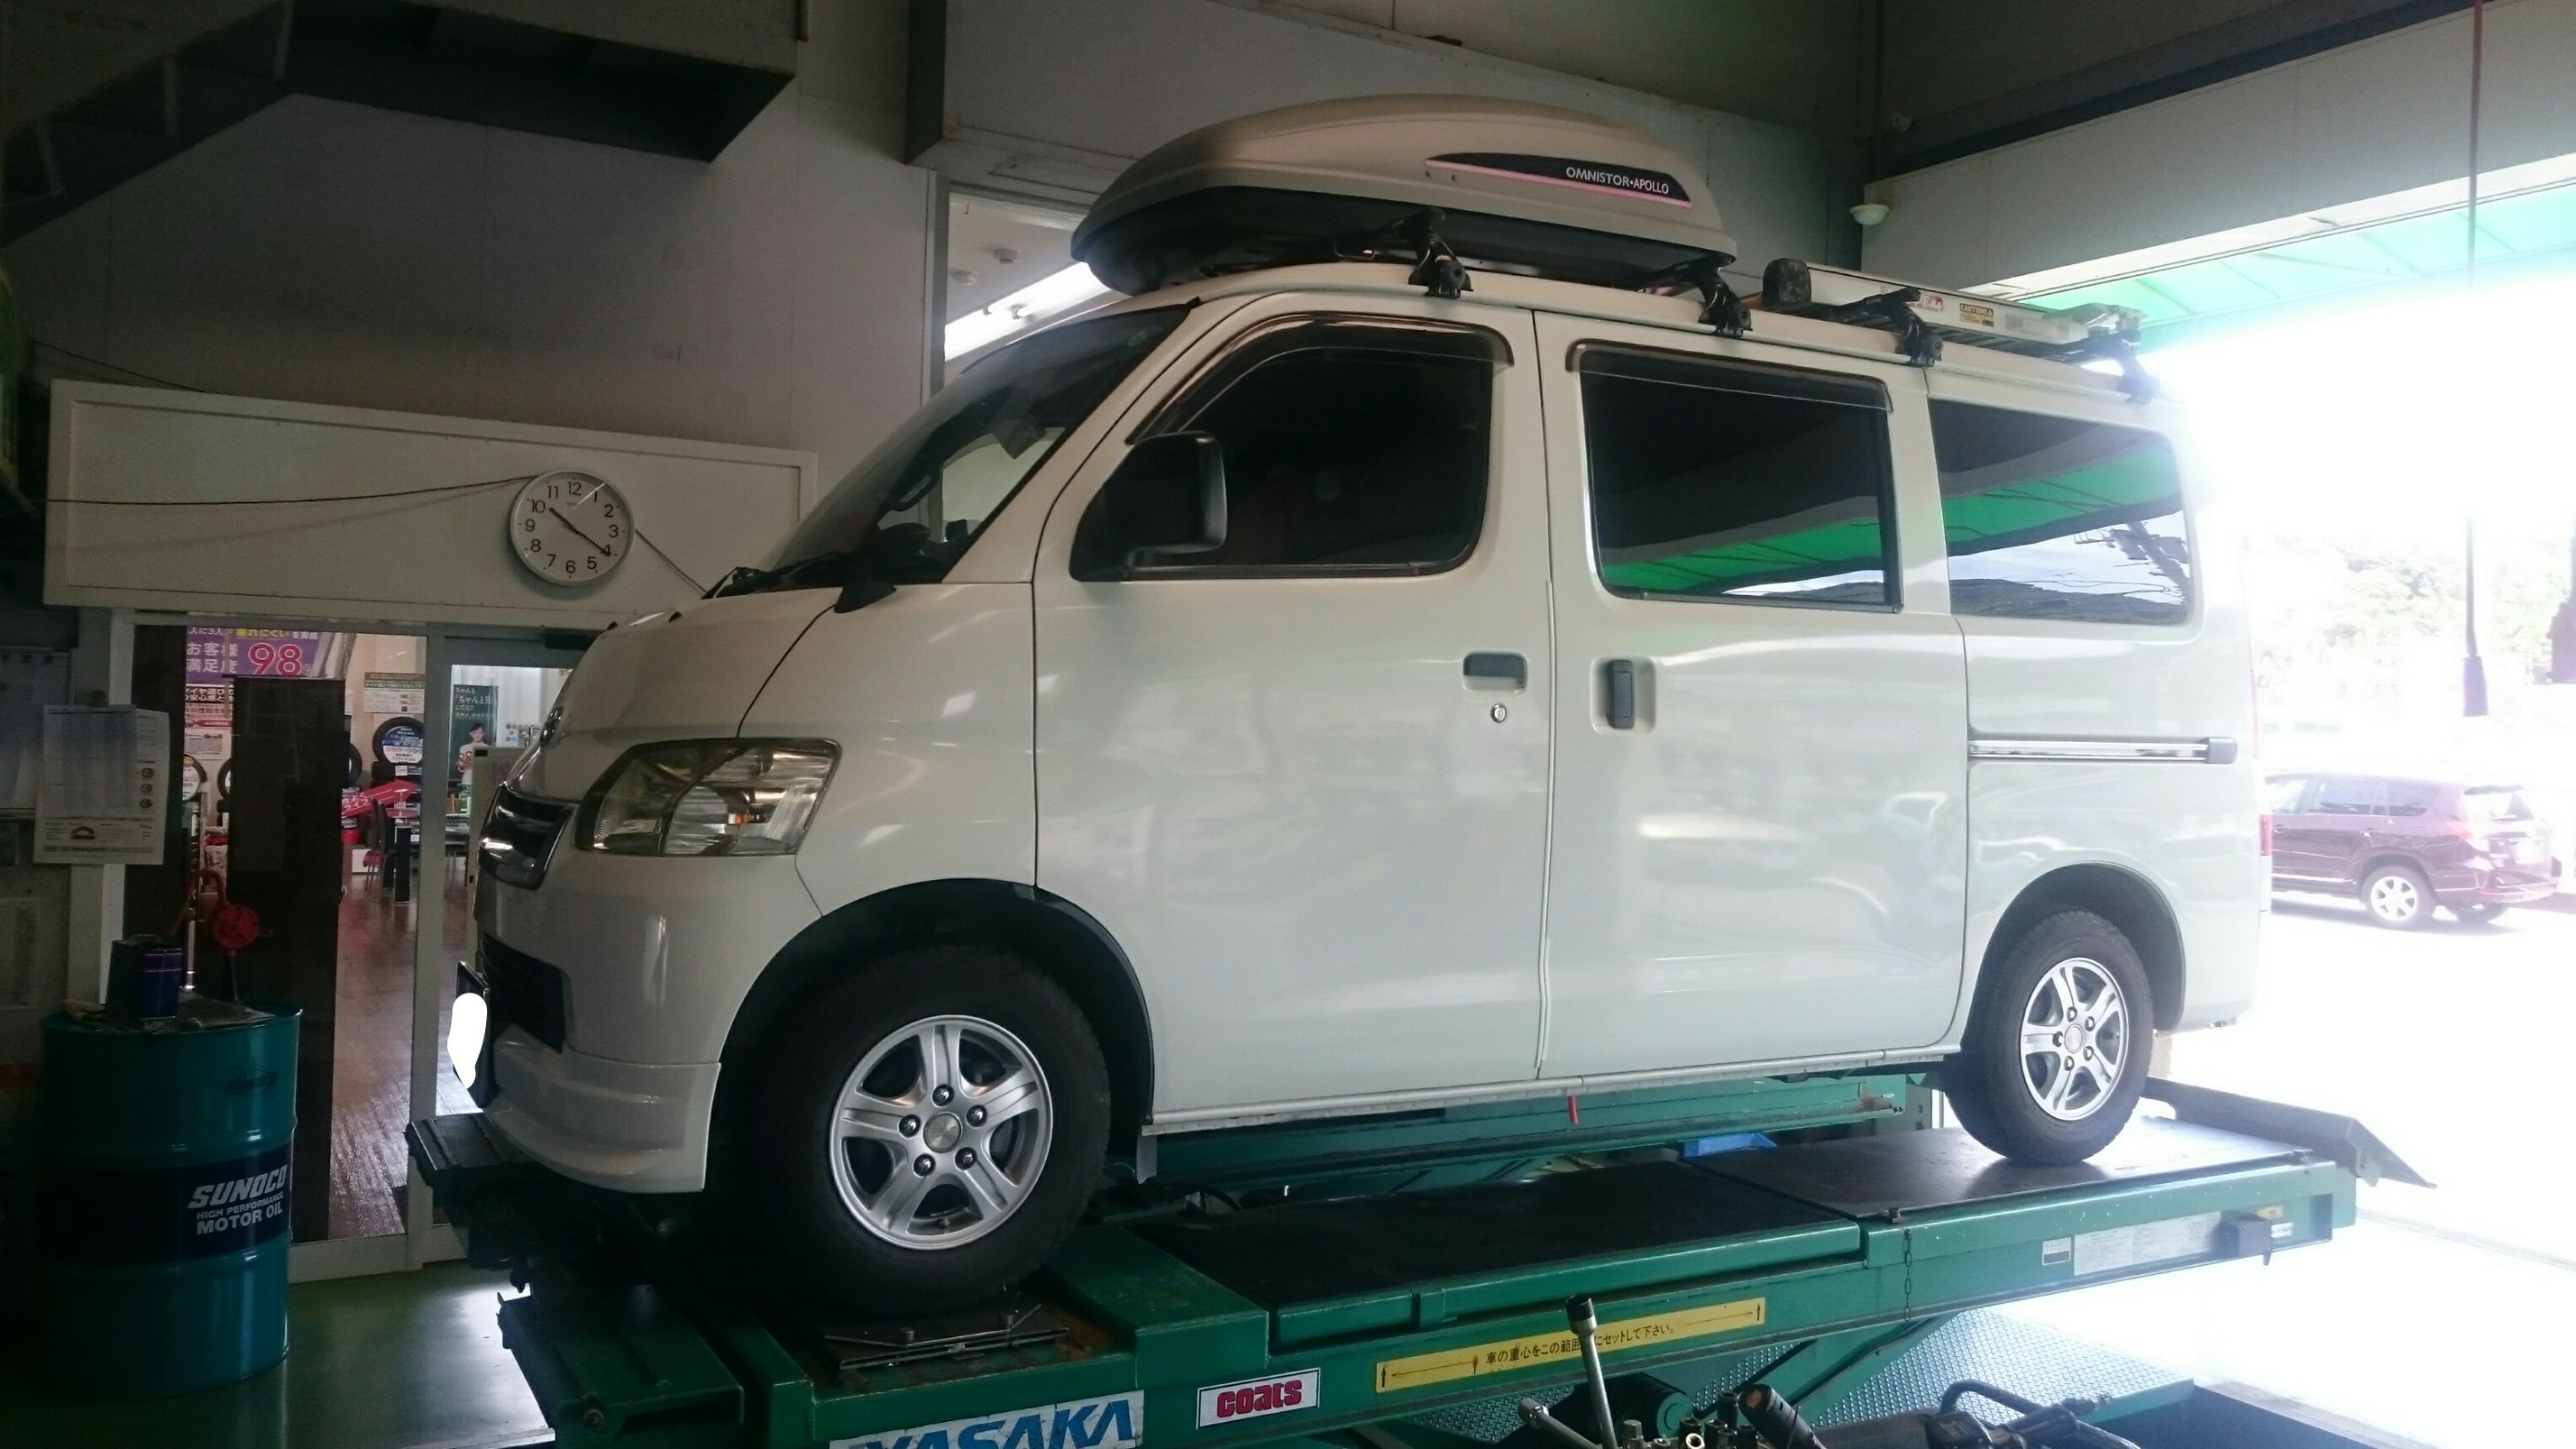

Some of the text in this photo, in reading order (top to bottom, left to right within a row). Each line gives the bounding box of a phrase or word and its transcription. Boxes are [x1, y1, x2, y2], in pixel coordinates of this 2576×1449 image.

[547, 485, 559, 499] 11
[567, 481, 582, 495] 12
[531, 499, 547, 513] 10
[603, 504, 614, 518] 2
[525, 519, 535, 533] 9
[608, 524, 618, 538] 3
[530, 539, 541, 552] 8
[601, 544, 612, 557] 4
[547, 553, 556, 567] 7
[565, 560, 575, 573] 6
[587, 556, 597, 570] 5
[188, 1165, 287, 1209] SUNOCO
[196, 1191, 284, 1220] HIGH PERFORMANCE
[196, 1202, 283, 1235] MOTOR OIL
